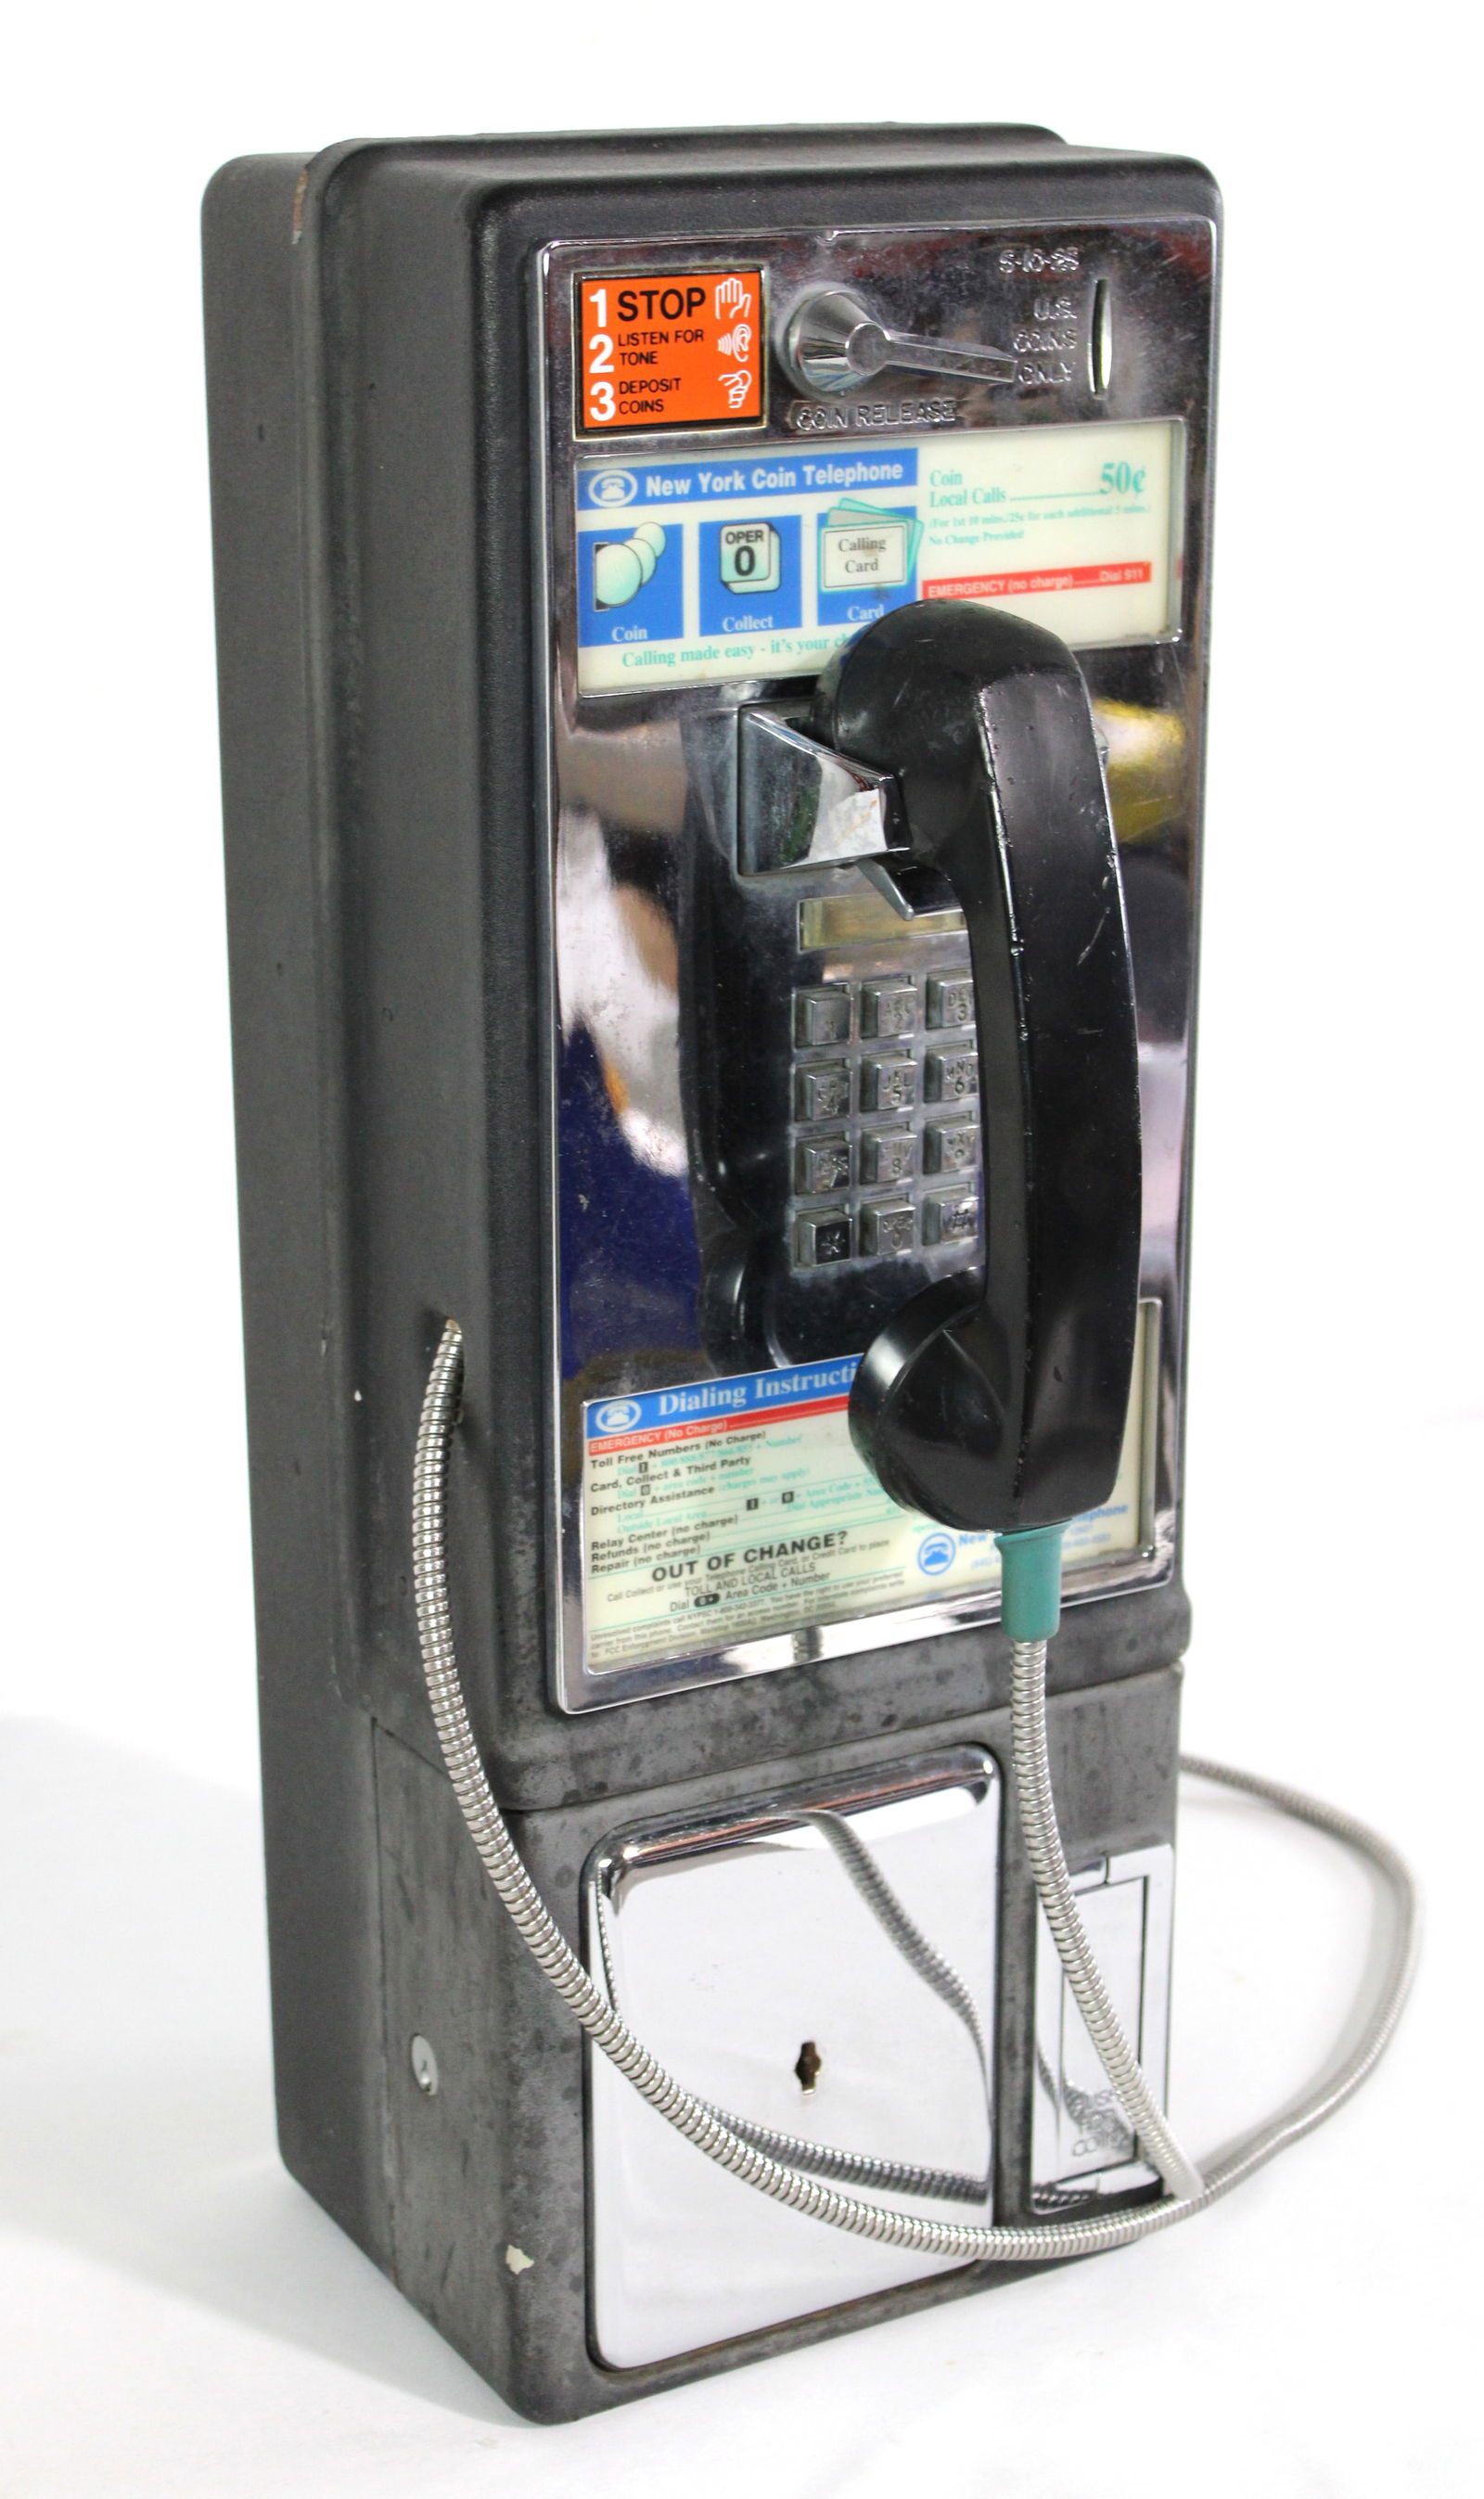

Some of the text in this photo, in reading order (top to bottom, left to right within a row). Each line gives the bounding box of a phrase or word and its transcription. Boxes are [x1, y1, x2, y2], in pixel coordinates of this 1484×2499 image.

[589, 287, 705, 327] 1 STOP
[589, 329, 704, 374] 2 LISTEN FOR
[620, 352, 658, 365] TONE
[590, 378, 682, 422] 3 DEPOSIT
[620, 399, 664, 415] COINS
[798, 397, 957, 430] COIN RELEASE
[646, 462, 903, 497] New York Coin Telephone
[929, 469, 963, 487] Coin
[929, 461, 1146, 508] Local Calls 50¢
[724, 529, 764, 545] OPER
[838, 536, 887, 553] Calling
[946, 534, 979, 545] Change
[735, 545, 756, 577] 0
[845, 558, 879, 574] Card
[928, 583, 1005, 598] EMERGENCY
[1008, 579, 1027, 594] (no
[1030, 575, 1074, 590] charge)
[1125, 568, 1144, 581] 911
[723, 616, 774, 633] Collect
[848, 604, 885, 622] Card
[612, 625, 648, 642] Coin
[622, 648, 676, 668] Calling
[681, 647, 721, 662] made
[724, 645, 754, 660] easy
[771, 638, 794, 654] it's
[799, 638, 831, 655] your
[835, 633, 853, 648] ch
[957, 1003, 967, 1021] 3
[954, 1076, 966, 1096] 6
[892, 1157, 902, 1176] 8
[659, 1361, 857, 1416] Dialing Instructi
[590, 1419, 726, 1453] EMERGENCY (No Charge)
[591, 1429, 765, 1468] Toll Free Numbers (No Charge)
[591, 1456, 749, 1493] Card, Collect & Third Party
[591, 1500, 644, 1516] Directory
[650, 1487, 714, 1504] Assistance
[592, 1513, 737, 1550] Relay Center (no charge)
[592, 1531, 710, 1561] Refunds (no charge)
[958, 1534, 986, 1546] New
[592, 1544, 699, 1573] Repair (no charge)
[652, 1529, 848, 1582] OUT OF CHANGE?
[626, 1584, 653, 1597] Collect
[670, 1598, 689, 1611] Dial
[724, 1589, 748, 1600] Area
[751, 1582, 778, 1594] Code
[790, 1572, 830, 1586] Number
[684, 1561, 815, 1596] TOLL AND LOCAL CALLS
